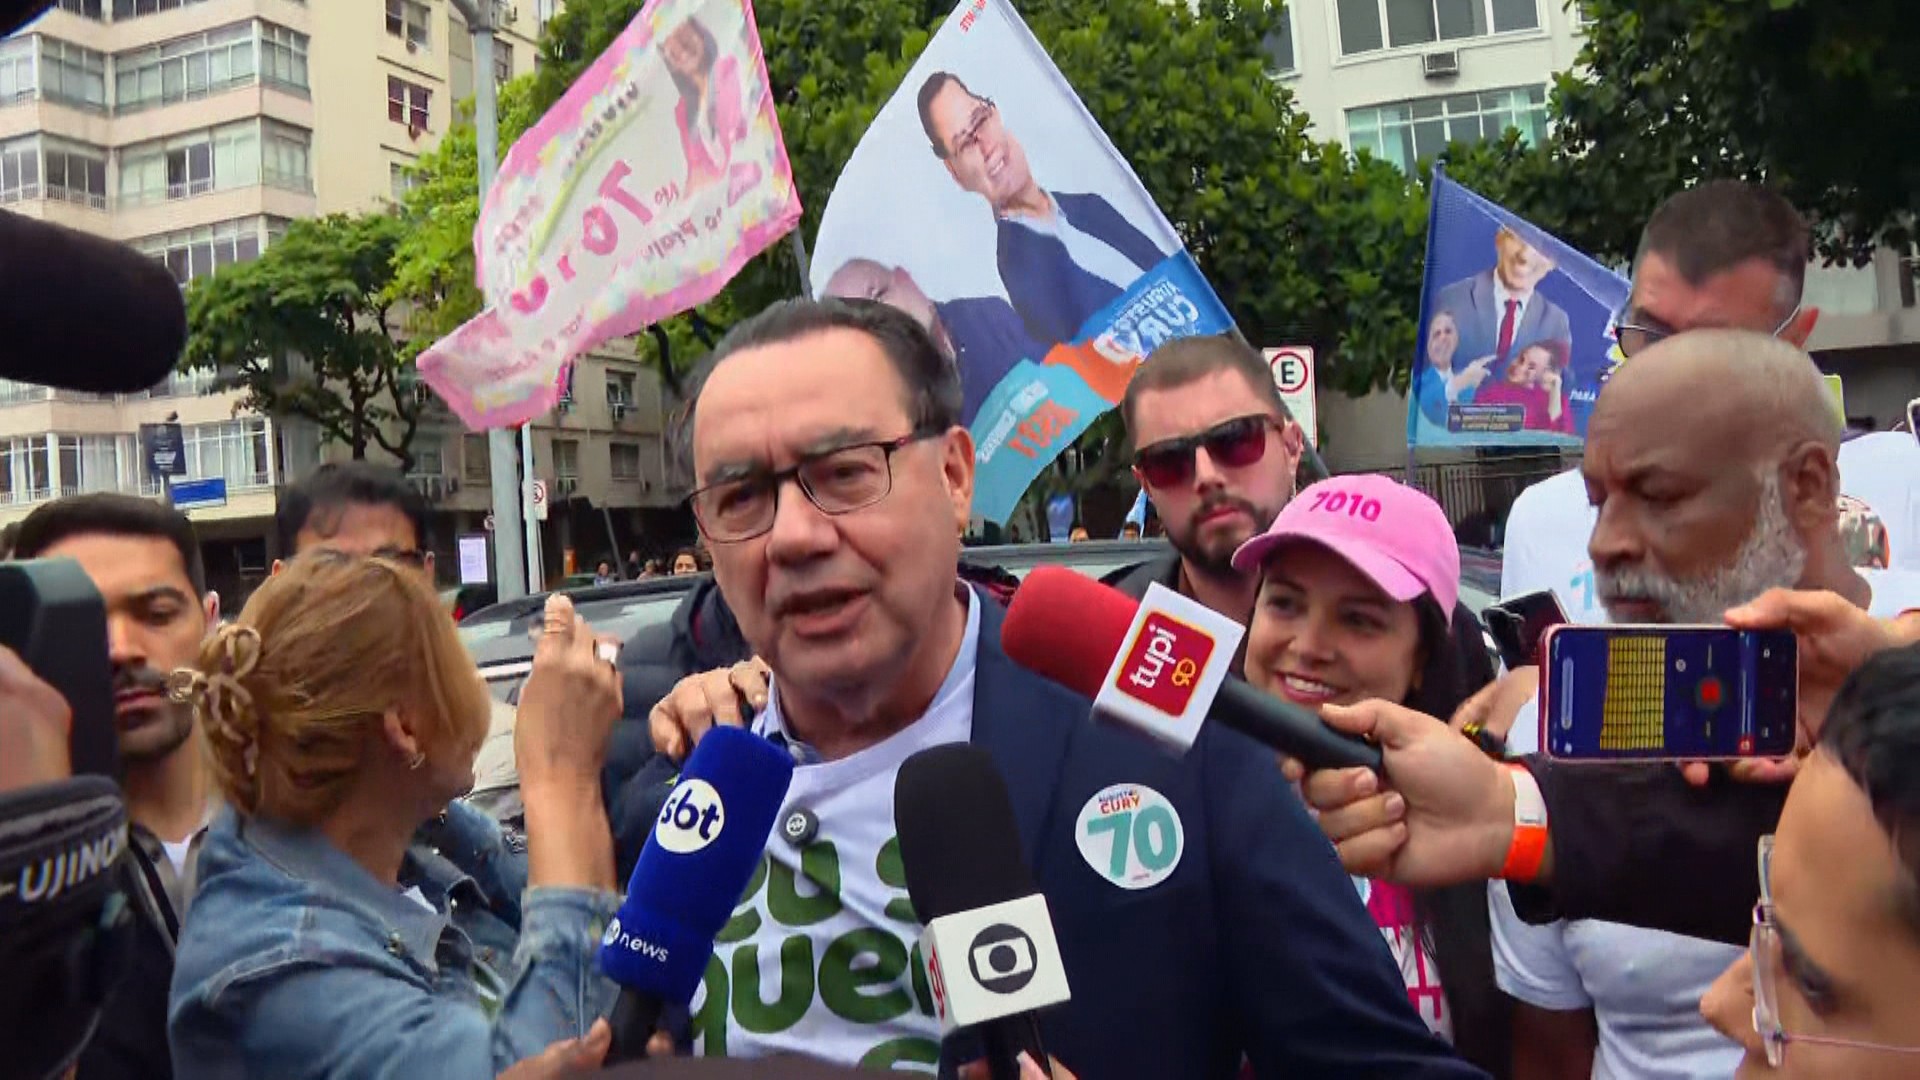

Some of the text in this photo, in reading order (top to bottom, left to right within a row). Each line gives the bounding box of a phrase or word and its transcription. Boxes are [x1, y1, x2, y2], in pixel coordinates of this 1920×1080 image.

[1281, 361, 1295, 384] E
[1309, 490, 1382, 522] 7010
[1129, 623, 1177, 689] tupi
[660, 787, 720, 841] sbt
[1101, 795, 1140, 814] CURY
[0, 825, 128, 901] UJINO
[1087, 804, 1178, 879] 70
[620, 931, 669, 962] news
